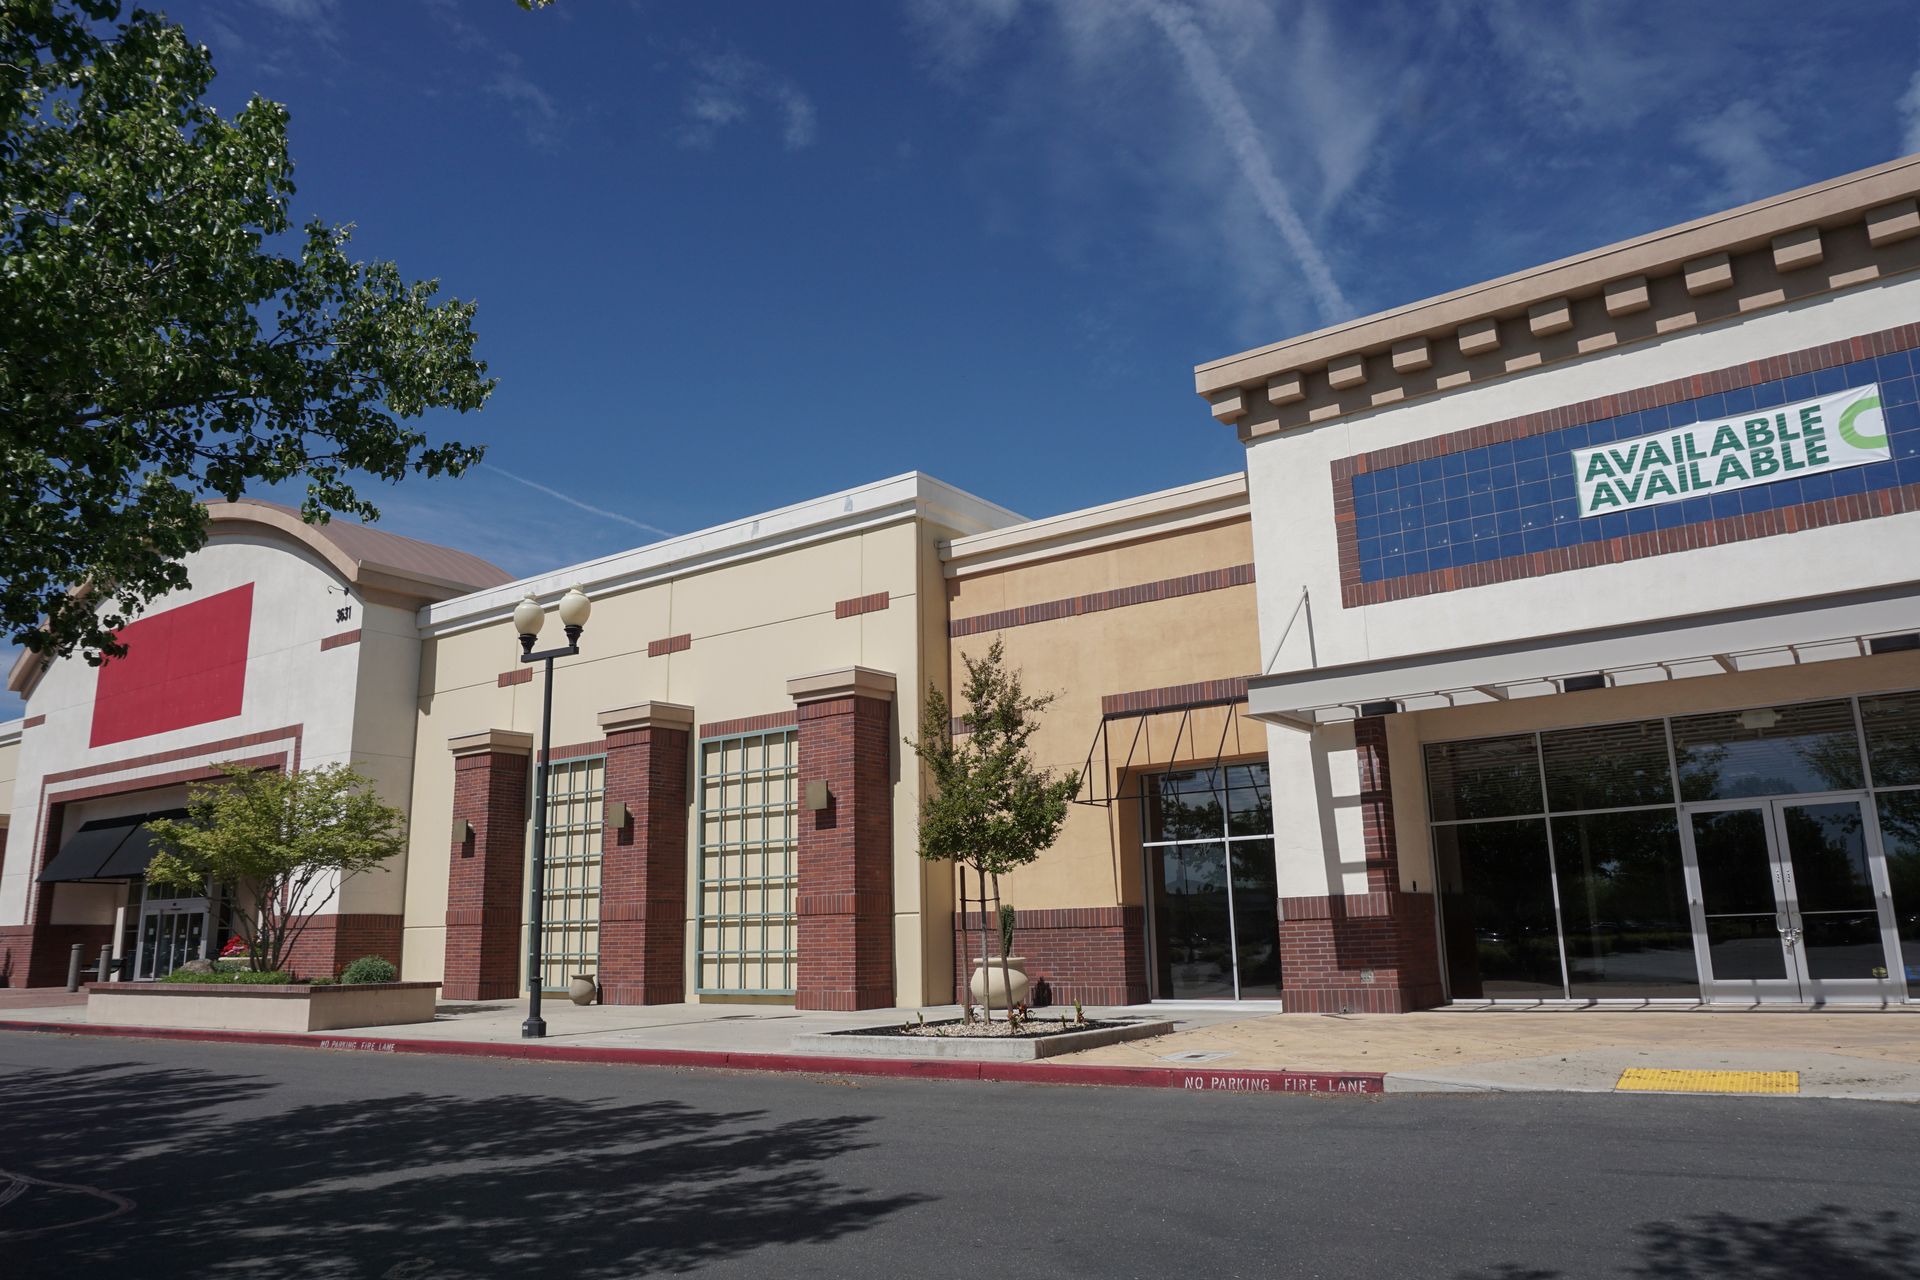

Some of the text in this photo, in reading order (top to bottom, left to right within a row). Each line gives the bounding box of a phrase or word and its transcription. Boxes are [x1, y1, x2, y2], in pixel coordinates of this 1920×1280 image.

[1584, 405, 1825, 482] AVAILABLE
[1590, 435, 1829, 510] AVAILABLE
[336, 606, 352, 623] 3631
[320, 1040, 396, 1051] NO PARKING FIRE LANE
[1185, 1077, 1368, 1094] NO PARKING FIRE LANE
